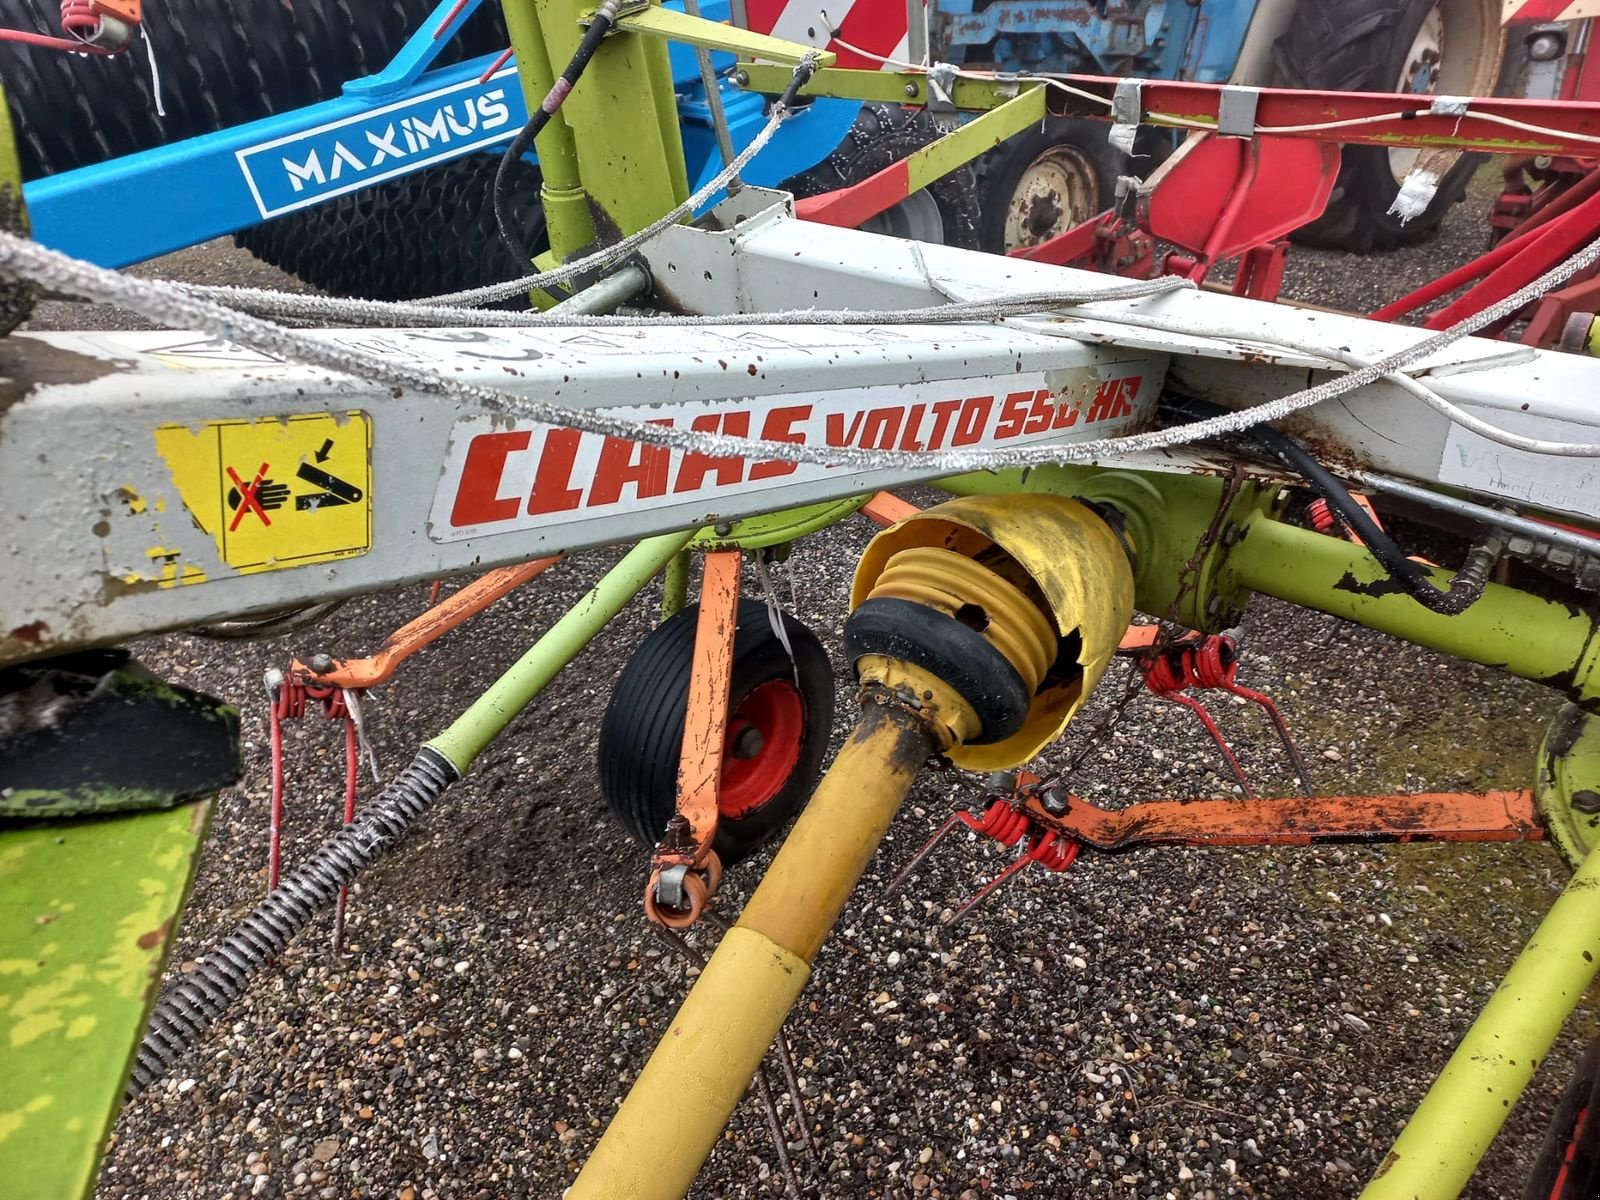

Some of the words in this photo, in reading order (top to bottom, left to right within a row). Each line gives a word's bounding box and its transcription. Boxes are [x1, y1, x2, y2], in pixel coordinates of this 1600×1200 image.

[282, 89, 509, 192] MAXIMUS
[450, 404, 814, 527] CLAAS
[825, 395, 995, 468] VOLTO
[1085, 376, 1143, 424] HR
